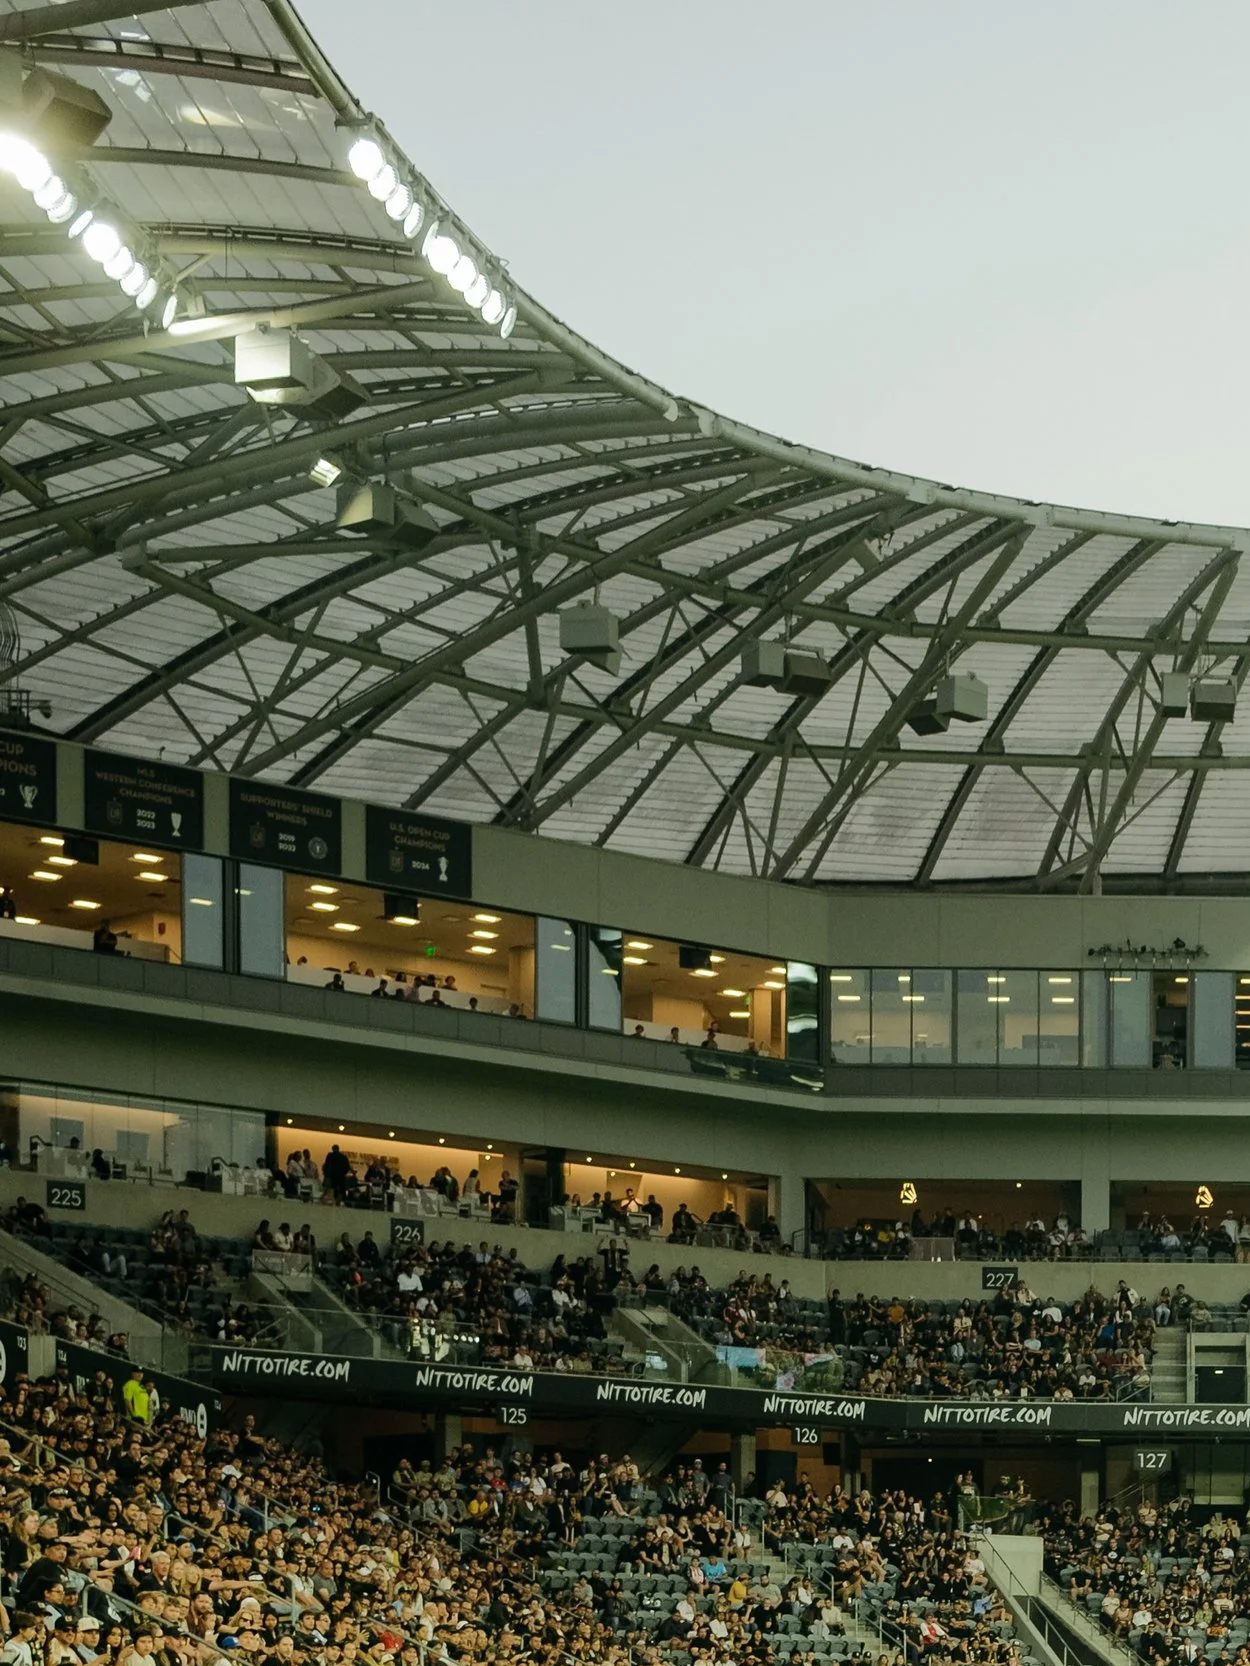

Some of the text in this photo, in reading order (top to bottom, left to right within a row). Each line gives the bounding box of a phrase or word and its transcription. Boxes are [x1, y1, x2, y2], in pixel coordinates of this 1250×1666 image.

[51, 1188, 82, 1207] 225
[394, 1225, 421, 1242] 226
[986, 1273, 1015, 1287] 227
[222, 1351, 350, 1382] NITTOTIRE.COM
[416, 1366, 533, 1396] NITTOTIRE.COM
[596, 1380, 706, 1409] NITTOTIRE.COM
[501, 1408, 527, 1425] 125
[763, 1394, 865, 1421] NITTOTIRE.COM
[924, 1403, 1051, 1426] NITTOTIRE.COM
[794, 1427, 818, 1444] 126
[1137, 1453, 1167, 1469] 127
